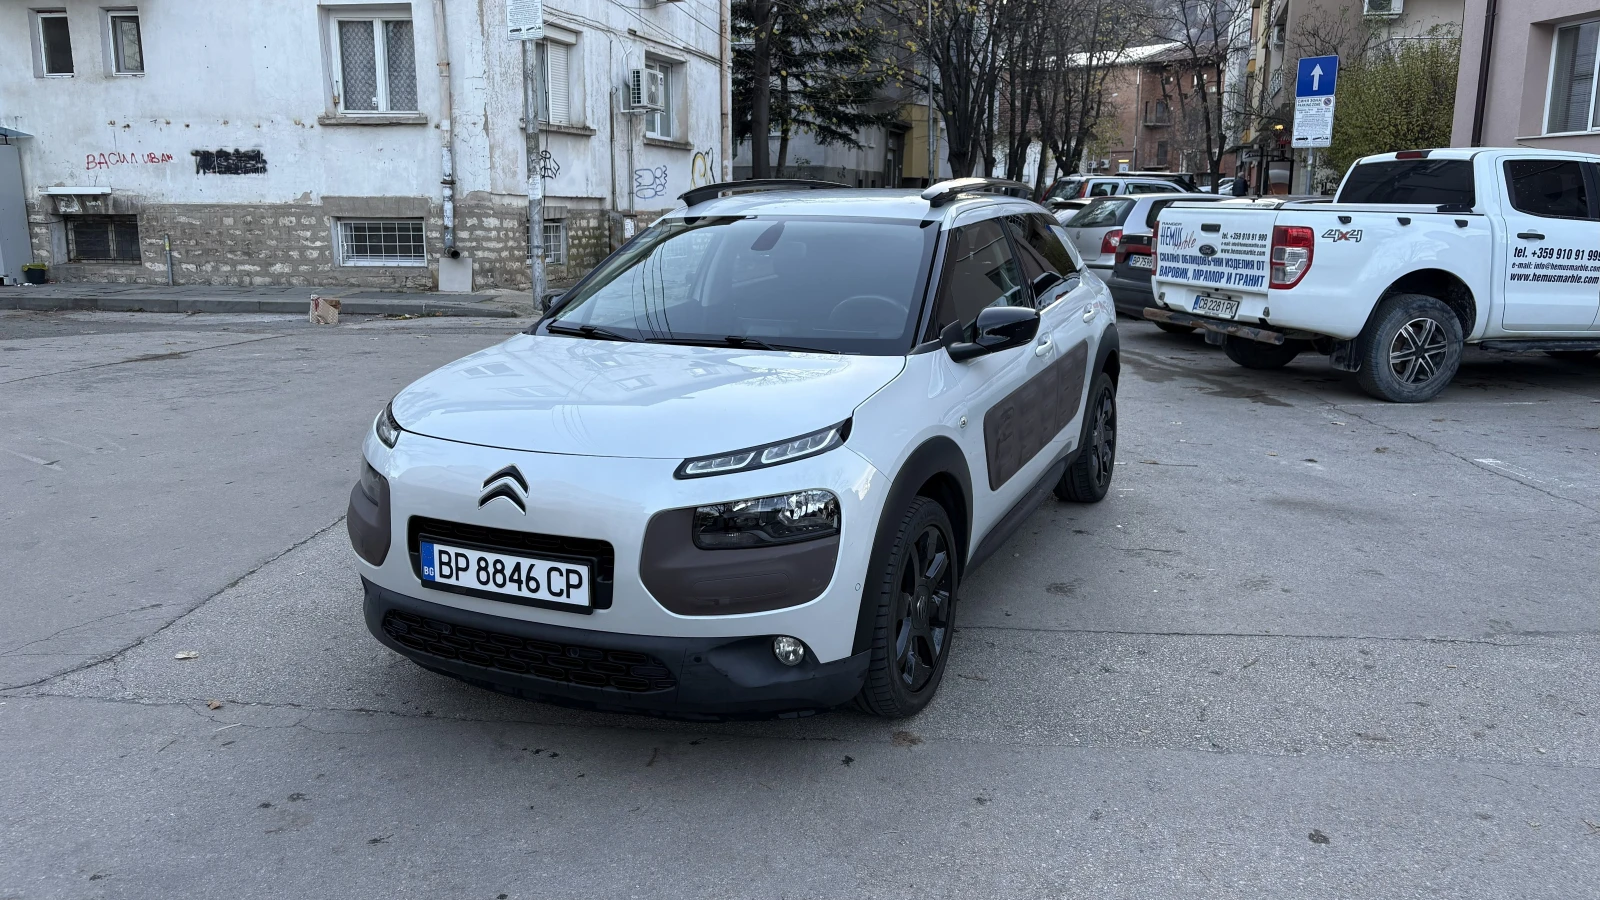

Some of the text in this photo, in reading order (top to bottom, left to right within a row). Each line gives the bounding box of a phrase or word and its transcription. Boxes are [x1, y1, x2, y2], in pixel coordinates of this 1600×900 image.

[86, 152, 138, 170] ВАСИЛ
[1160, 226, 1183, 246] HEMUS
[1160, 252, 1180, 264] СКАЛНО
[1225, 257, 1255, 270] ИЗДЕЛИЯ
[1256, 260, 1265, 271] ОТ
[1513, 246, 1528, 258] tel.
[1531, 247, 1554, 259] +359
[1556, 248, 1573, 260] 910
[1574, 249, 1585, 261] 91
[1159, 265, 1265, 287] ВАРОВИК, МРАМОР И ГРАНИТ
[1510, 272, 1599, 284] www.hemusmarble.com
[1198, 298, 1208, 310] CB
[1208, 299, 1225, 312] 2281
[424, 567, 434, 576] BG
[438, 549, 583, 598] BP 8846 CP
